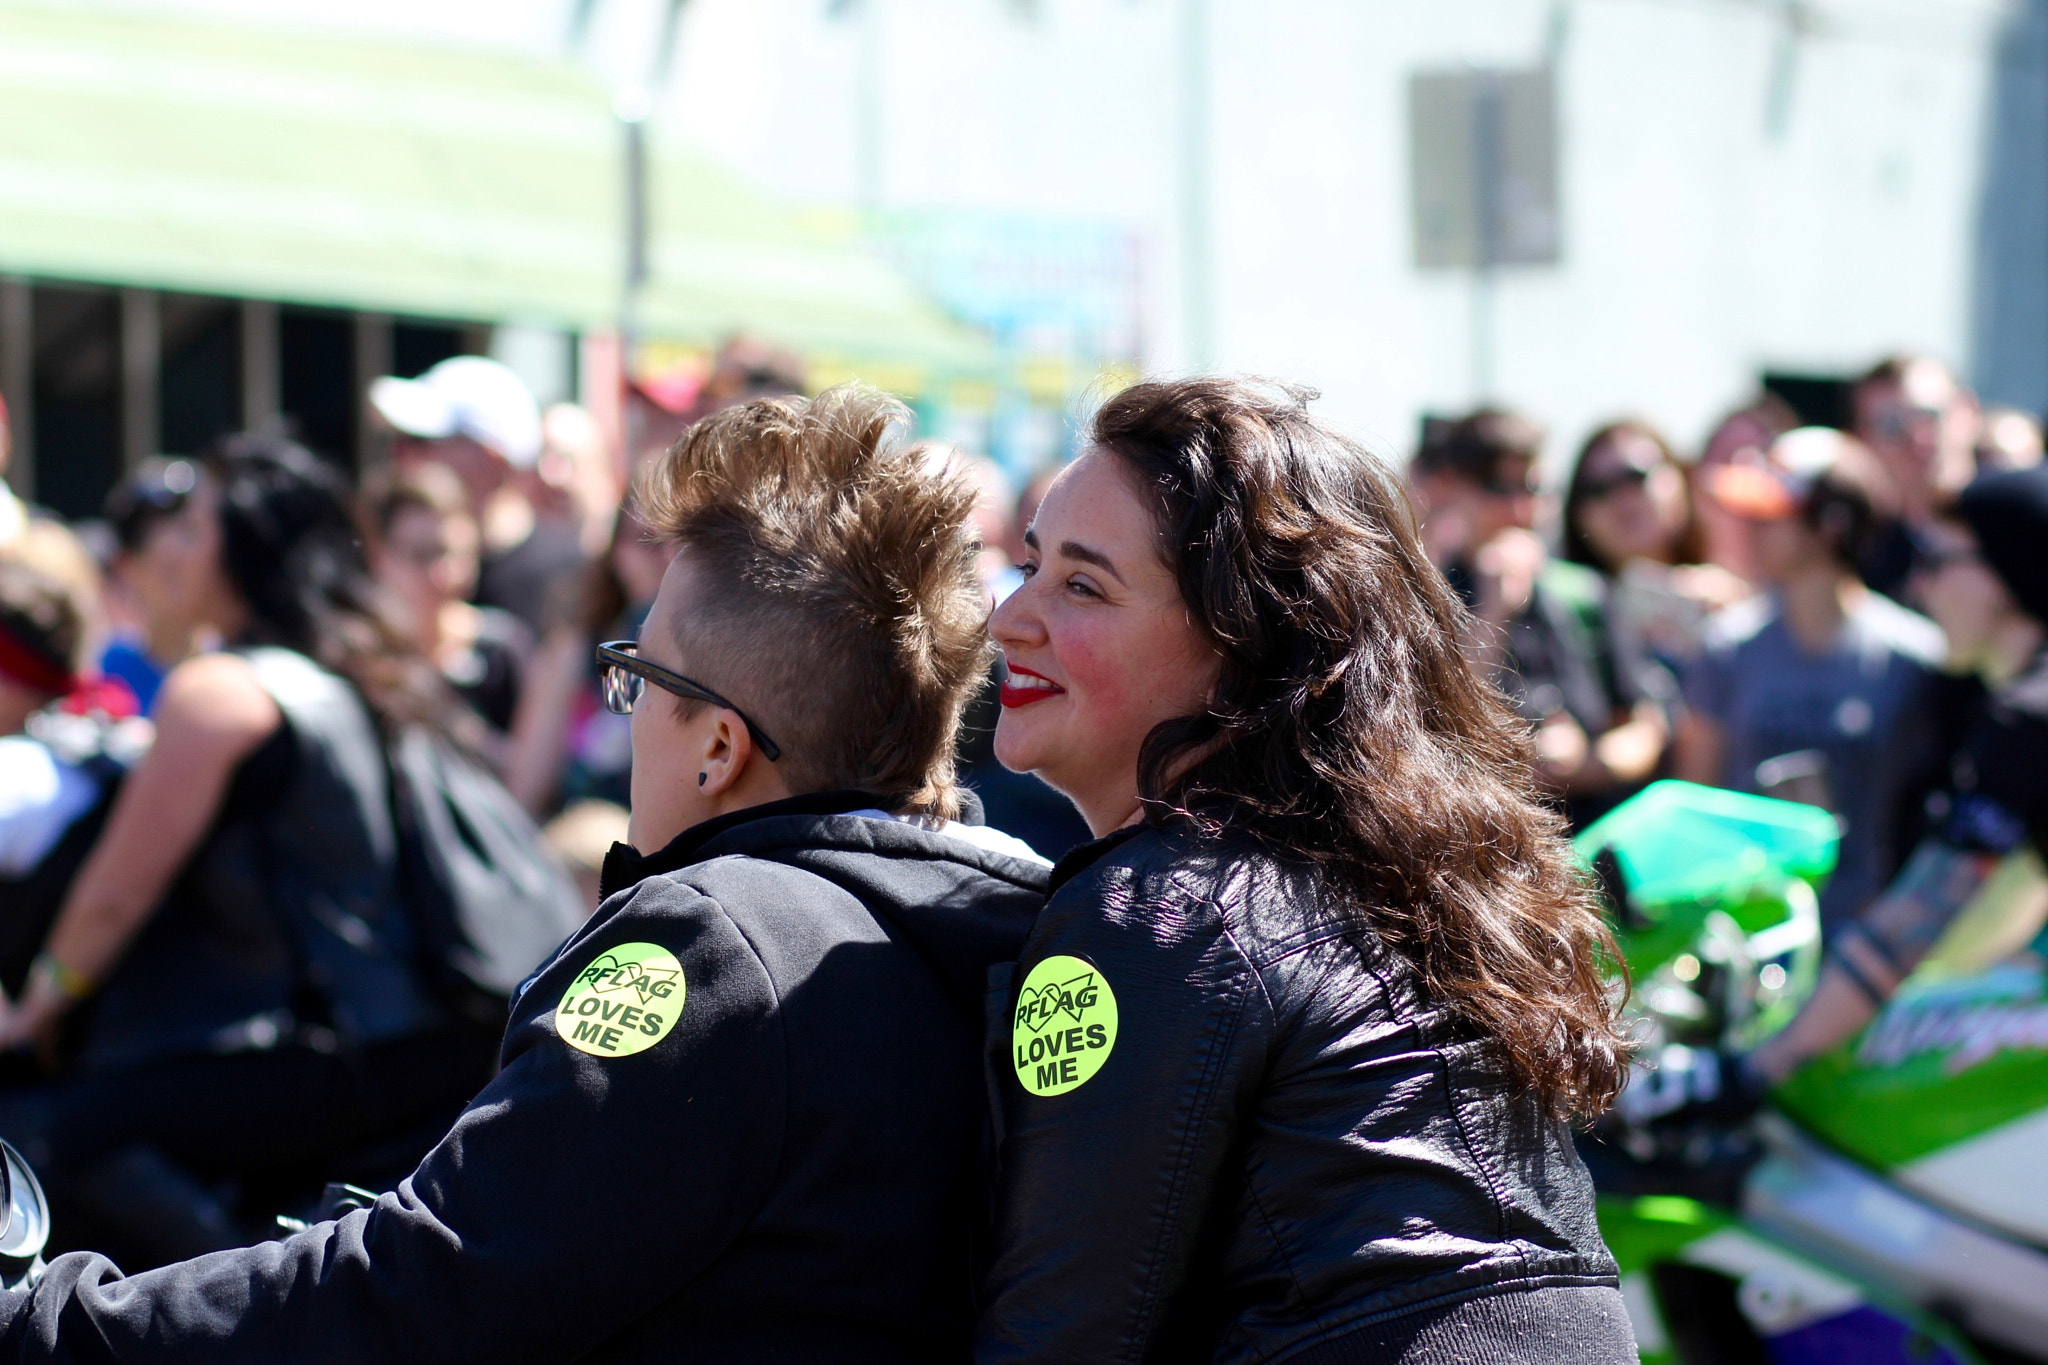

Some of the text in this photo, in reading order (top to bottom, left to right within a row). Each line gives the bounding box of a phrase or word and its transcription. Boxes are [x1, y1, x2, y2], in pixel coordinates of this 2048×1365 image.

[576, 967, 677, 999] PFLAG
[560, 996, 664, 1036] LOVES
[1015, 985, 1098, 1030] PFLAG
[571, 1020, 624, 1052] ME
[1017, 1023, 1107, 1069] LOVES
[1036, 1057, 1079, 1090] ME
